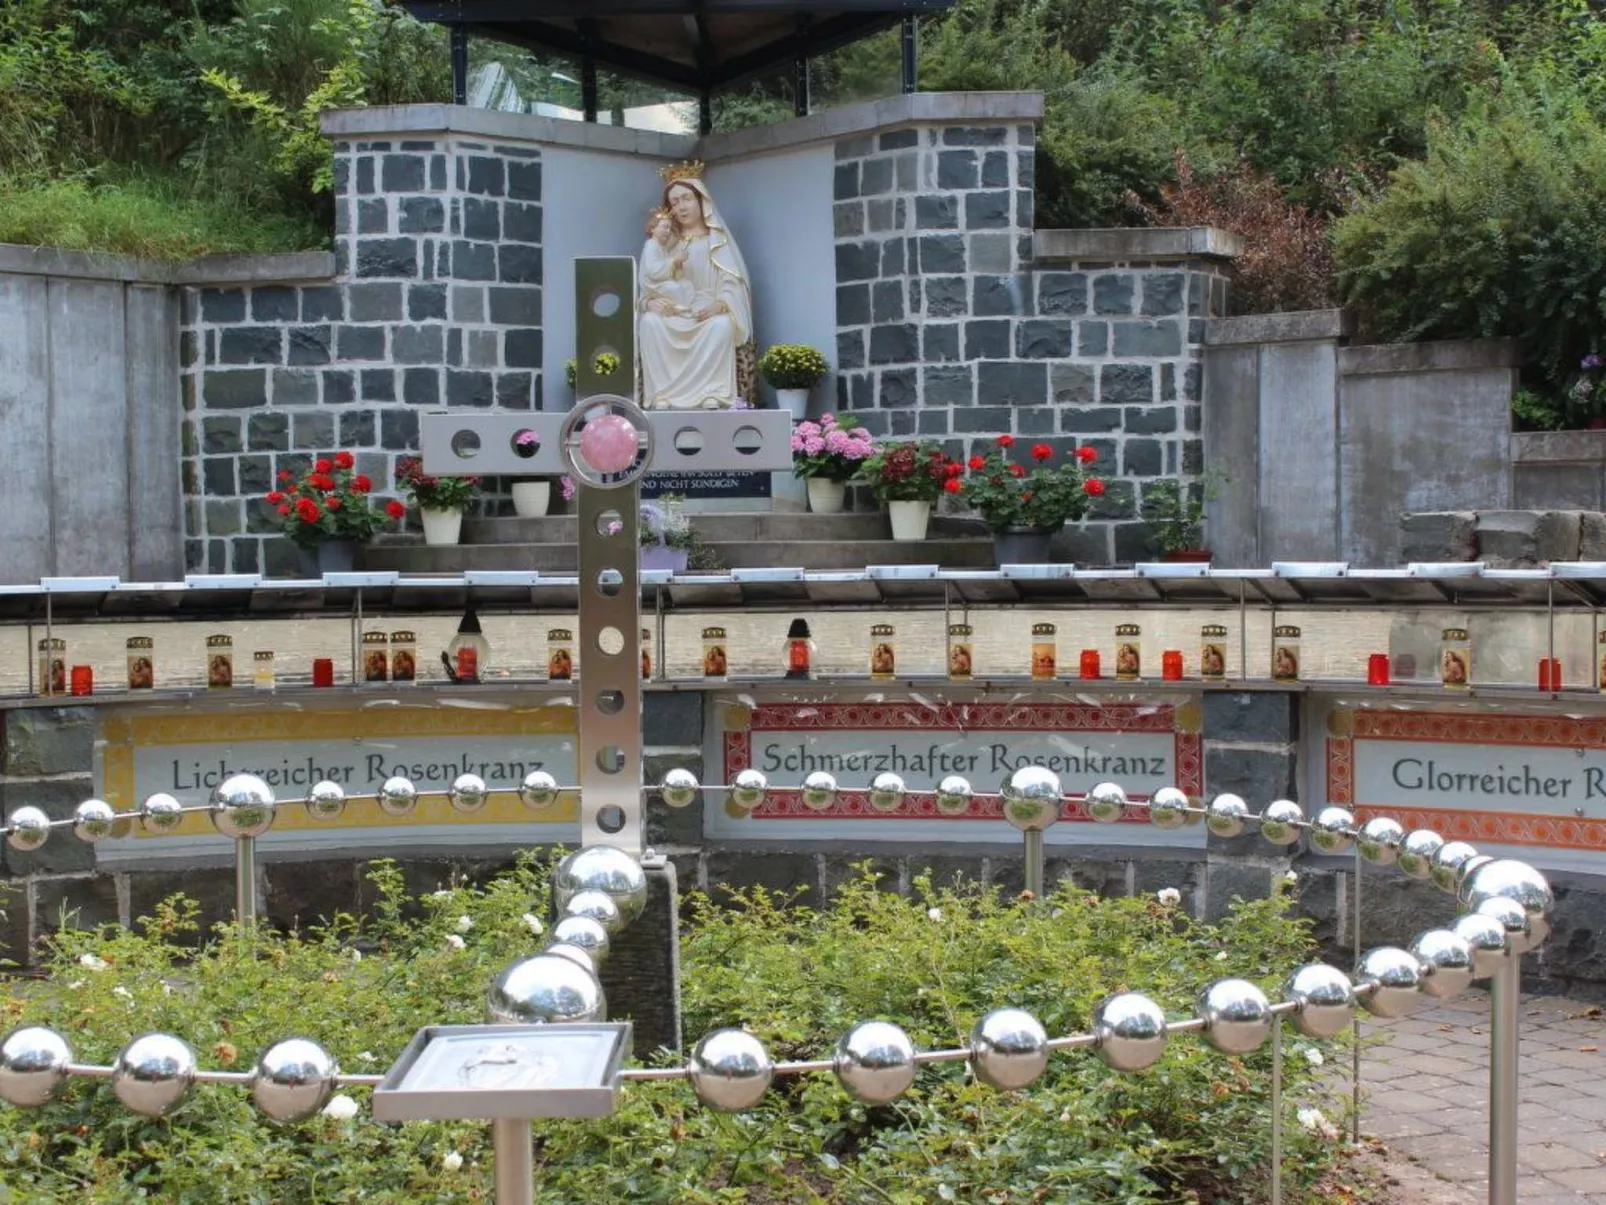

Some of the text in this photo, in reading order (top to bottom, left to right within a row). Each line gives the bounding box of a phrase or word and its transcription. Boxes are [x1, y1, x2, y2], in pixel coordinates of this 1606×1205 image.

[640, 480, 657, 489] ND
[660, 480, 688, 489] NICHT
[762, 743, 1166, 777] Schmerzhafter Rosenkranz
[1392, 758, 1573, 798] Glorreicher
